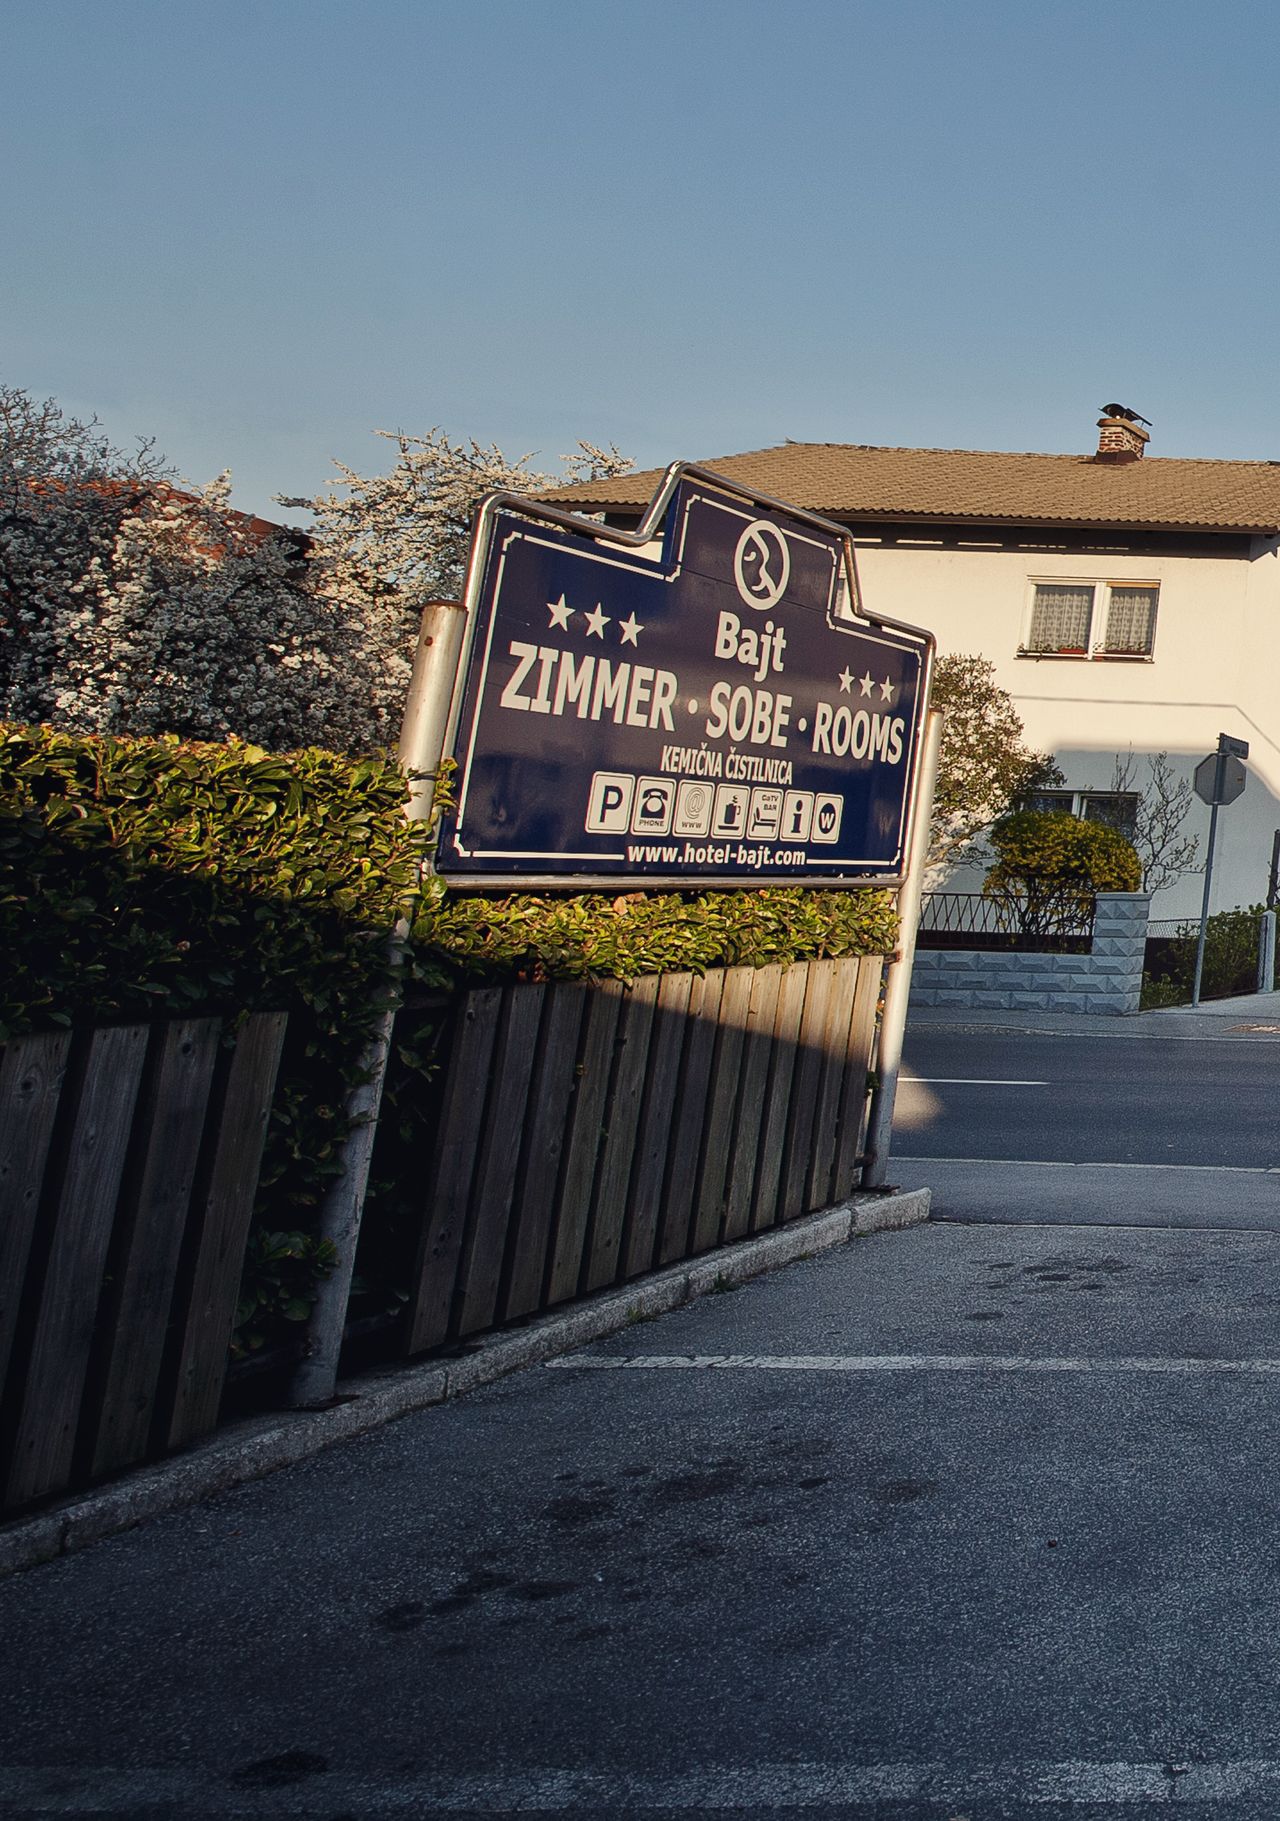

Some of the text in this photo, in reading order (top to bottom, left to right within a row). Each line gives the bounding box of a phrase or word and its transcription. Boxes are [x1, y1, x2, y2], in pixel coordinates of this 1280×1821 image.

[714, 610, 787, 683] Bajt
[499, 640, 905, 765] ZIMMER SOBE ROOMS
[660, 742, 793, 785] KEMIČNA ČISTILNICA
[599, 785, 624, 823] P
[639, 819, 664, 827] PHONE
[627, 842, 806, 869] www.hotel-bajt.com
